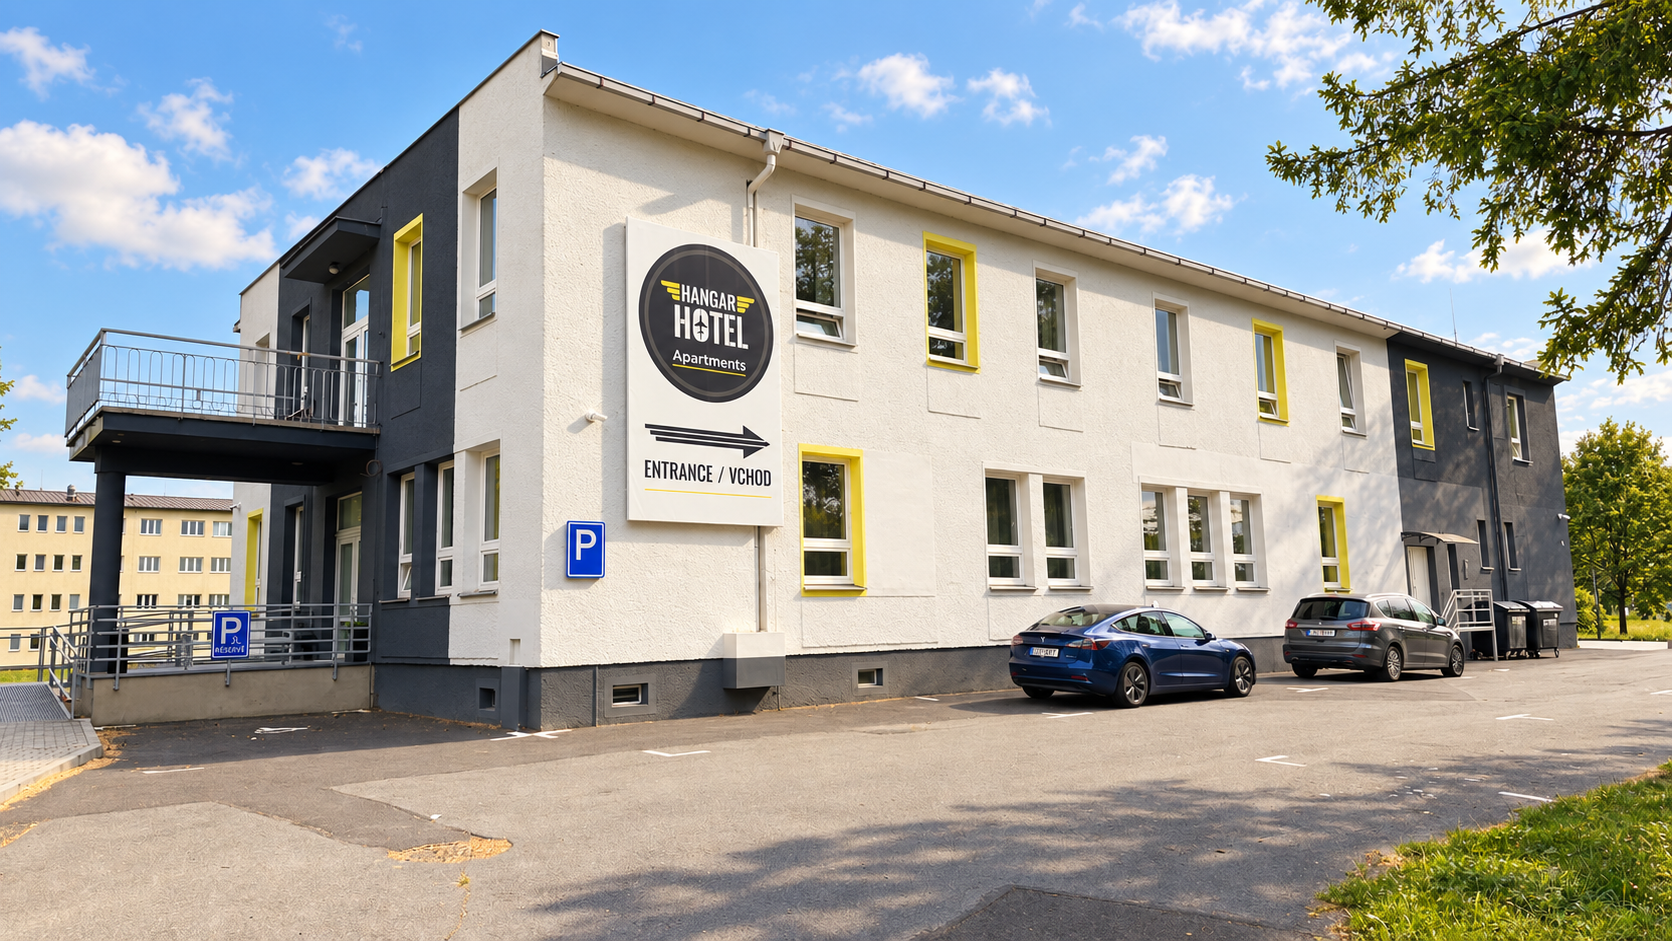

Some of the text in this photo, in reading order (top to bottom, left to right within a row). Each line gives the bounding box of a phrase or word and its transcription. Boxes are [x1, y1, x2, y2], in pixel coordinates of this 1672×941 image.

[681, 284, 736, 312] HANGAR
[674, 304, 749, 350] HOTEL
[672, 349, 747, 371] Apartments
[644, 459, 772, 487] ENTRANCE / VCHOD
[576, 529, 597, 561] P
[220, 616, 242, 645] P
